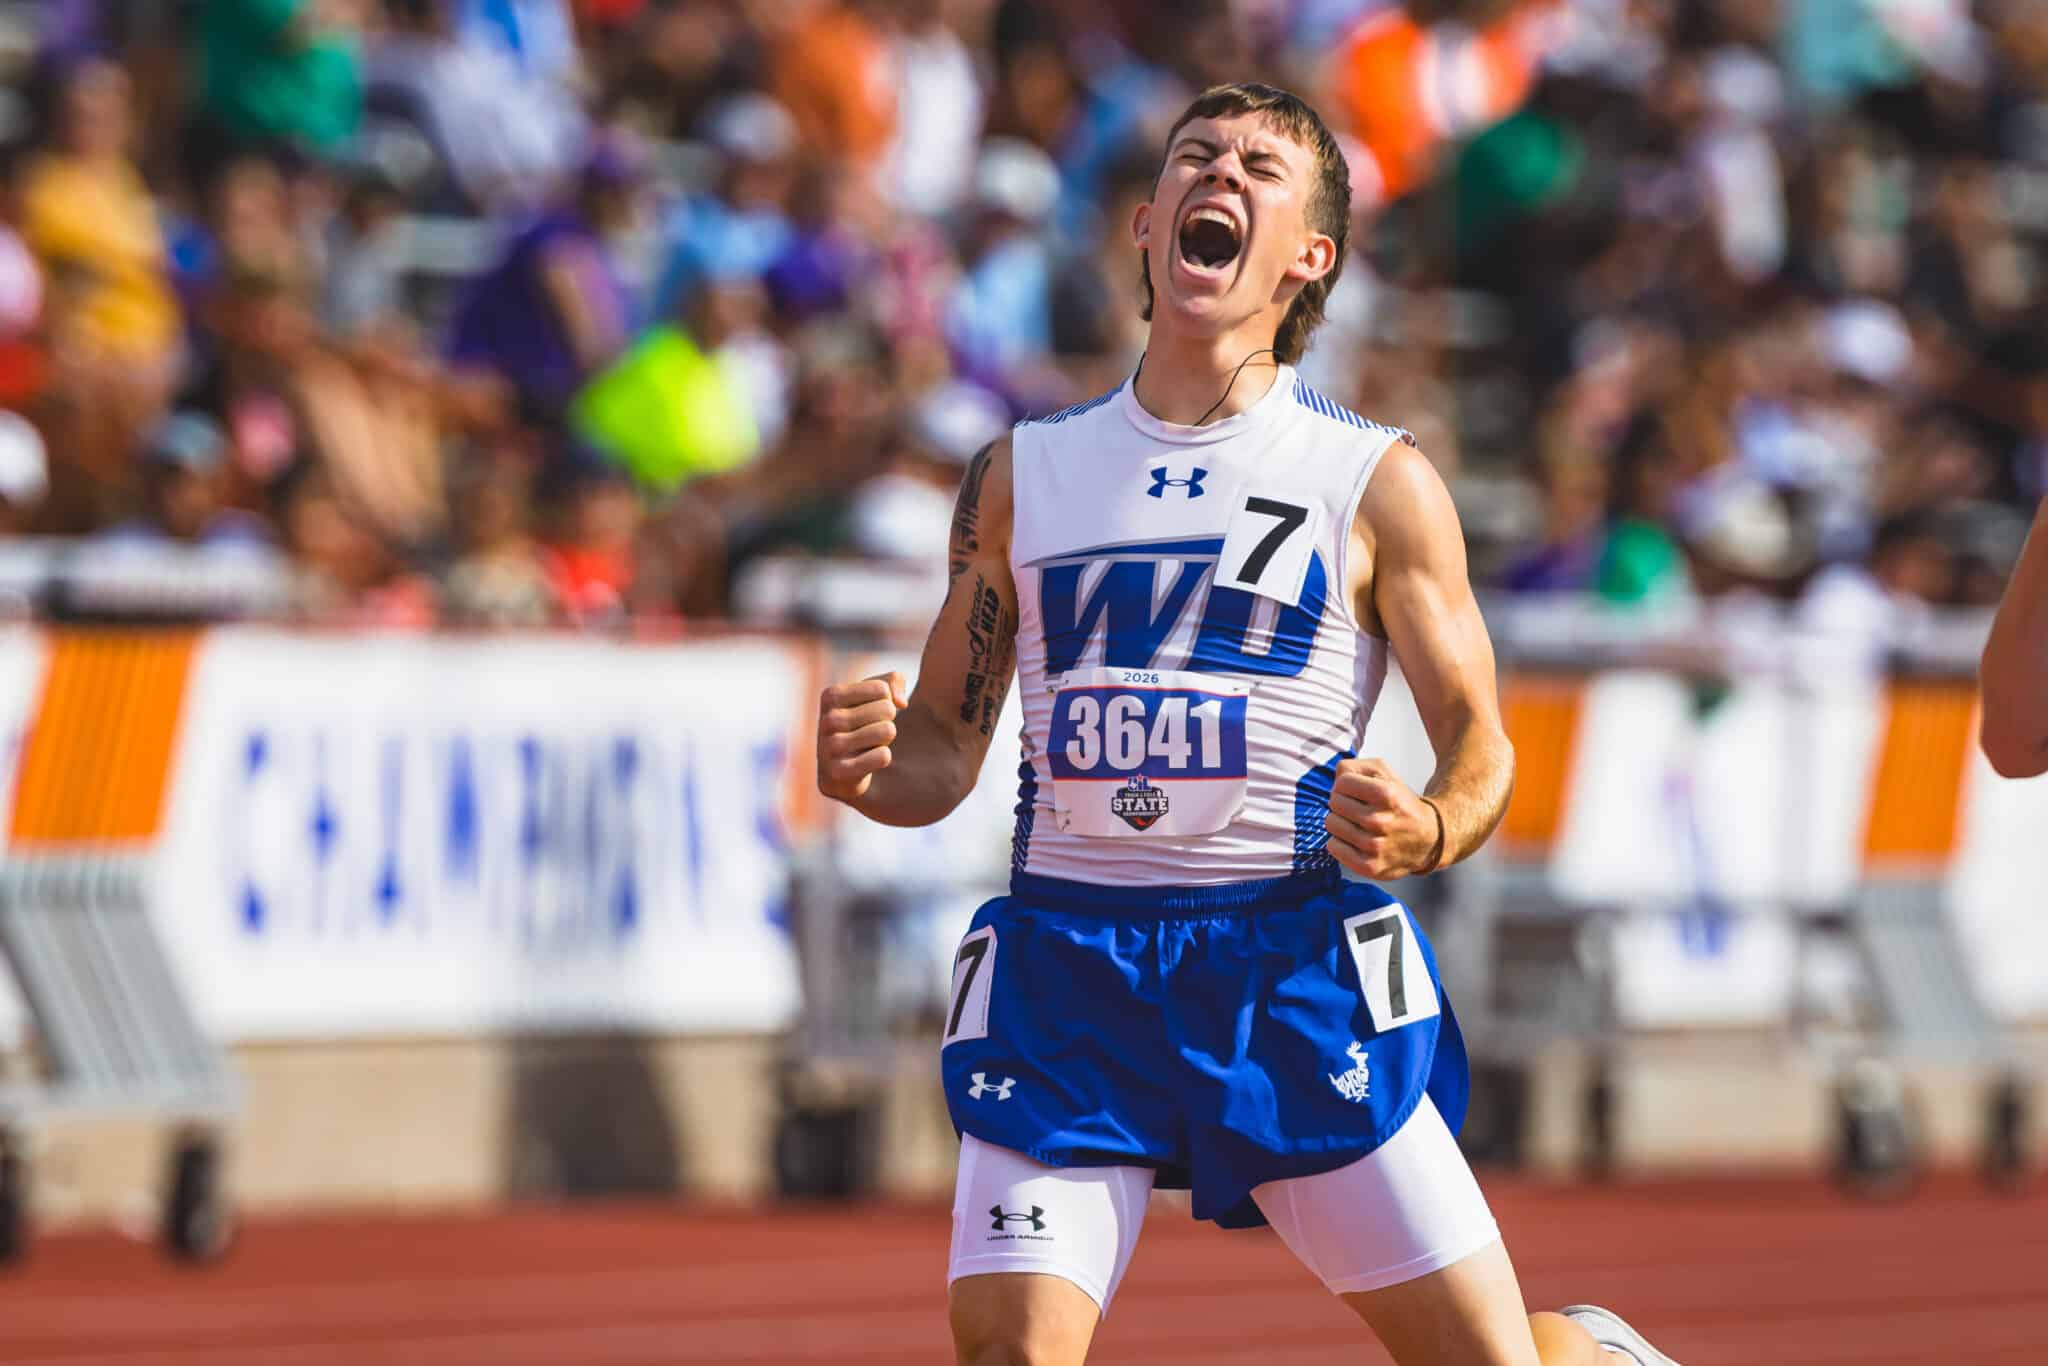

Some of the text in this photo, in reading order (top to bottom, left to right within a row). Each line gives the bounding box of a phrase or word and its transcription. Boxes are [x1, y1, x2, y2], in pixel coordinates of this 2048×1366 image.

[1236, 496, 1308, 585] 7
[1123, 672, 1159, 684] 2026
[1066, 694, 1222, 770] 3641
[1112, 797, 1168, 811] STATE
[947, 935, 990, 1037] 7
[1353, 914, 1408, 1019] 7
